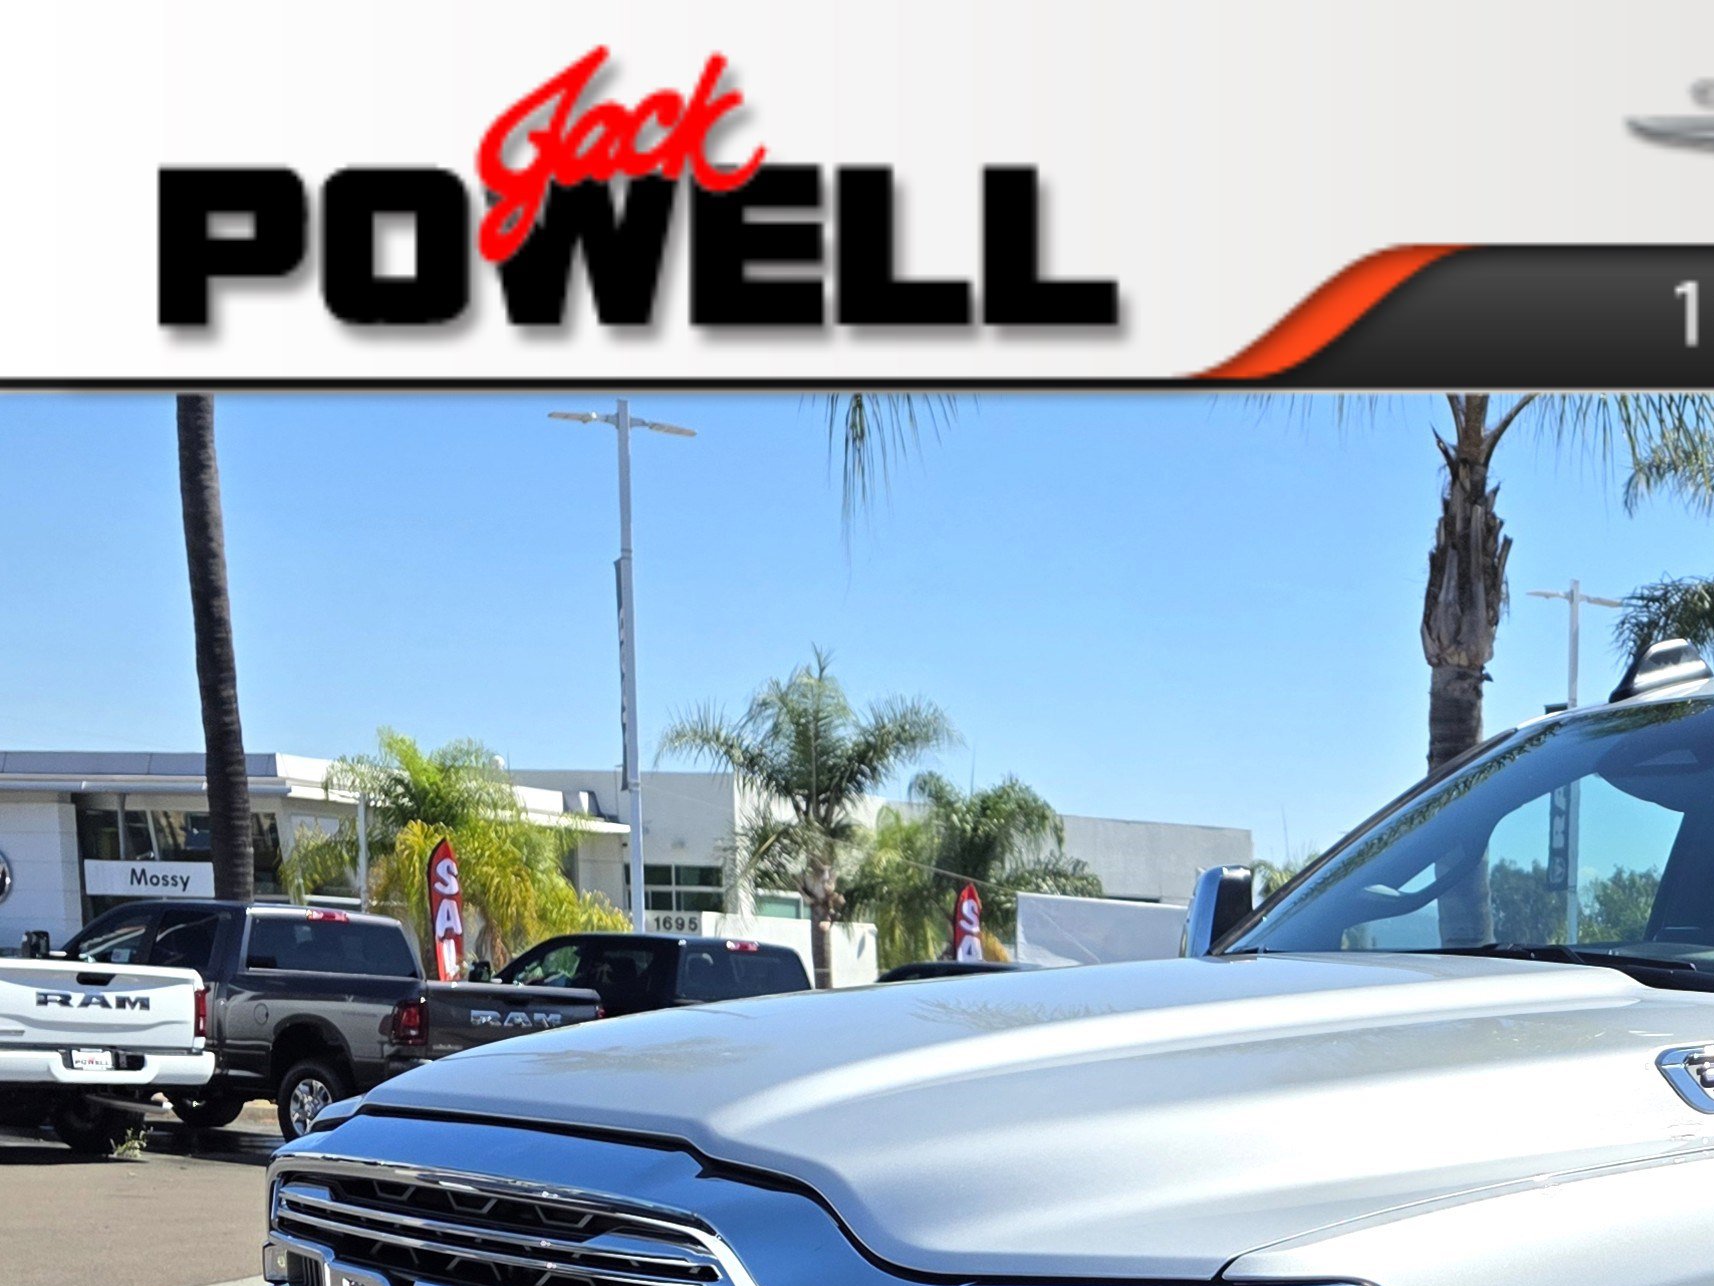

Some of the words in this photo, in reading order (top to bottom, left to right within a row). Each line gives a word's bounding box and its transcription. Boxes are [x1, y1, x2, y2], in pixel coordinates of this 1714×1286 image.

[130, 867, 191, 892] Mossy
[654, 915, 699, 932] 1695
[36, 991, 151, 1011] RAM
[470, 1009, 562, 1028] RAM
